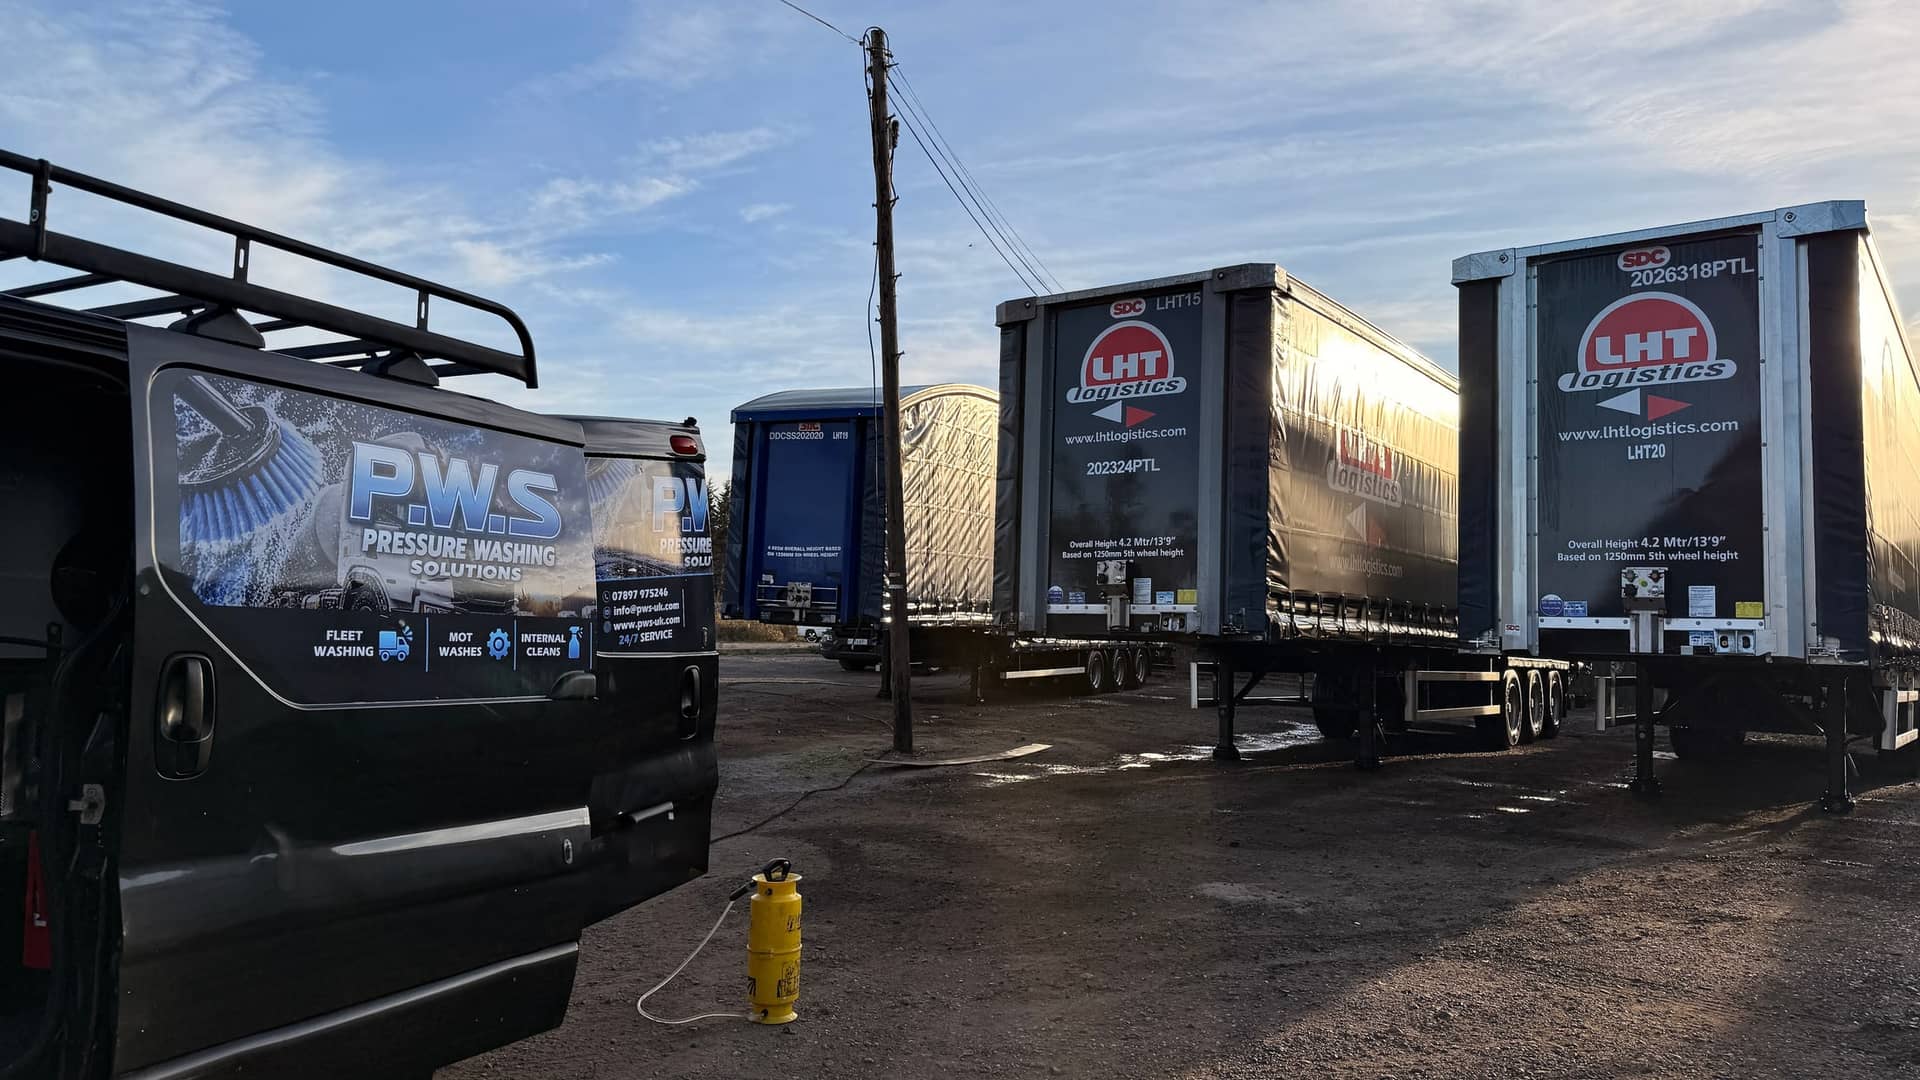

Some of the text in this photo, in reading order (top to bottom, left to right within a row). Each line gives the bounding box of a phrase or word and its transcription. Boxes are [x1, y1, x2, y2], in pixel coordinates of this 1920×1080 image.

[1623, 249, 1665, 268] SDC
[1631, 257, 1755, 288] 2026318PTL
[1113, 300, 1143, 316] SDC
[1156, 292, 1201, 311] LHT15
[1595, 327, 1698, 365] LHT
[1092, 350, 1162, 381] LHT
[1568, 362, 1726, 389] logistics
[1073, 379, 1180, 402] logistics
[1065, 427, 1187, 445] www.lhtlogistics.com
[1558, 420, 1739, 442] www.lhtlogistics.com
[1627, 443, 1666, 460] LHT20
[1087, 458, 1161, 475] 202324PTL
[350, 441, 562, 539] P.W.S
[1331, 464, 1399, 502] logistics
[361, 528, 556, 567] PRESSURE WASHING
[660, 537, 712, 554] PRESSURE
[1069, 540, 1094, 549] Overall
[1094, 540, 1118, 549] Height
[1118, 537, 1132, 547] 4.2
[1568, 539, 1602, 549] Overall
[1605, 539, 1638, 550] Height
[1641, 537, 1660, 548] 4.2
[684, 555, 712, 568] SOLU
[1062, 551, 1082, 559] Based
[1123, 550, 1136, 558] 5th
[1137, 549, 1159, 557] wheel
[1160, 549, 1184, 558] height
[1557, 552, 1586, 562] Based
[1604, 552, 1646, 561] 1250mm
[1648, 551, 1666, 561] 5th
[1668, 551, 1701, 561] wheel
[1703, 550, 1739, 562] height
[410, 559, 522, 582] SOLUTIONS
[612, 587, 669, 601] 07897 975246
[613, 600, 680, 617] info@pws-uk.com
[613, 615, 681, 632] www.pws-uk.com
[326, 630, 364, 642] FLEET
[448, 632, 473, 643] MOT
[521, 633, 566, 644] INTERNAL
[618, 629, 673, 647] 24/7 SERVICE
[314, 646, 375, 657] WASHING
[439, 646, 482, 657] WASHES
[526, 647, 561, 657] CLEANS
